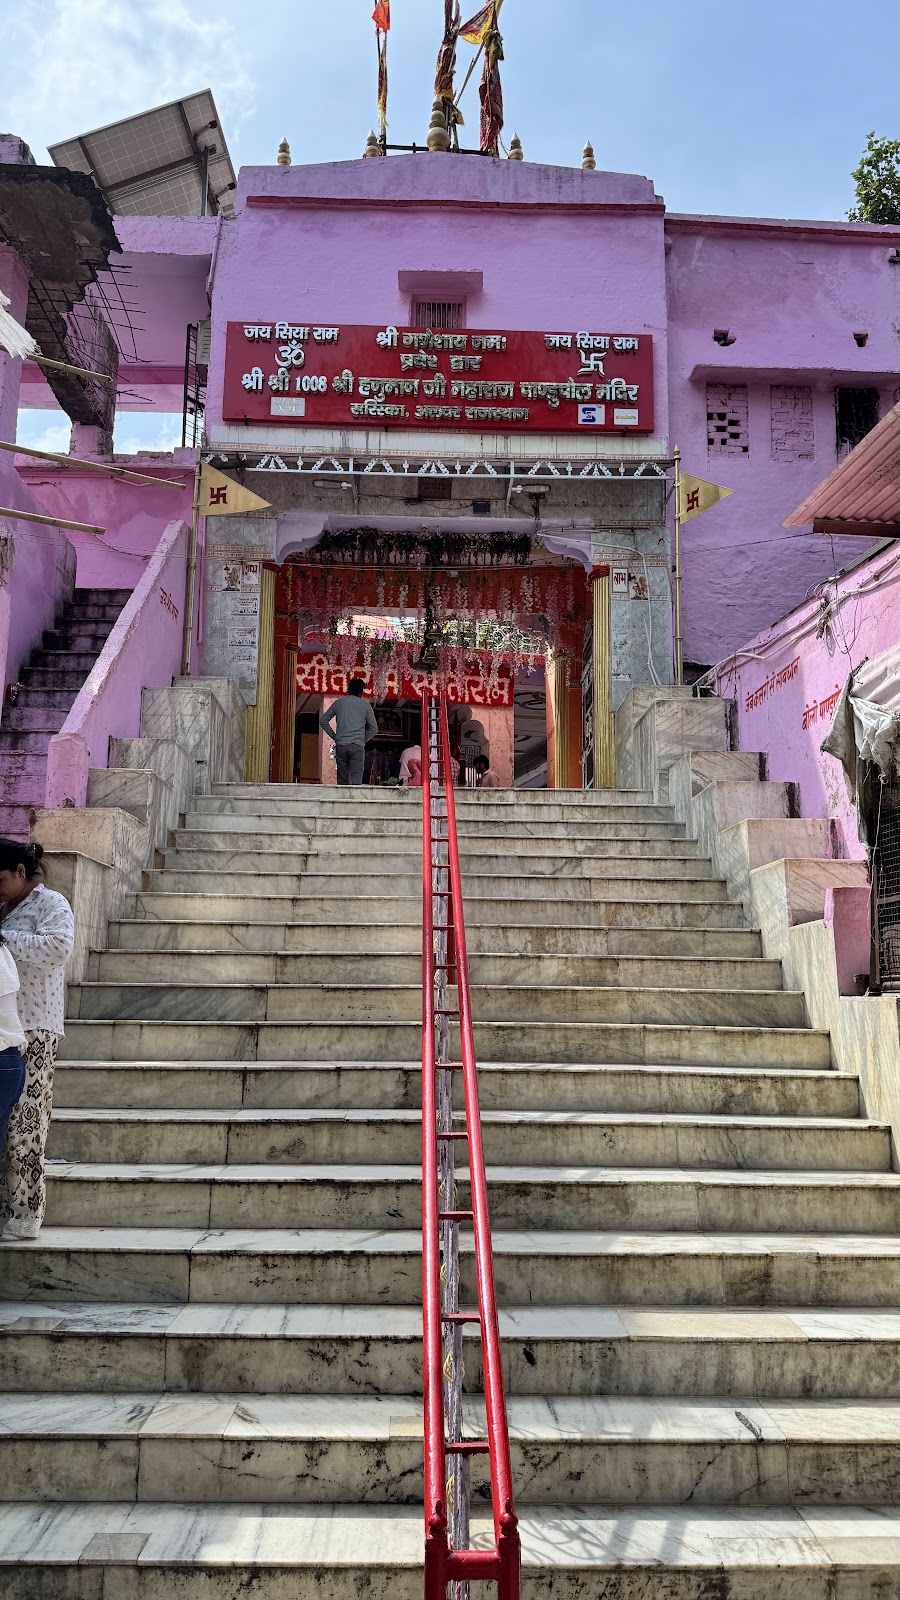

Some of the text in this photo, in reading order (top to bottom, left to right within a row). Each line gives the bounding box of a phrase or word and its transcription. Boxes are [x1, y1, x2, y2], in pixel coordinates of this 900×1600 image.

[243, 321, 339, 342] जय सिया राम
[376, 326, 507, 352] श्री गणेशाय नमः
[544, 330, 640, 351] जय सिया राम
[449, 355, 482, 372] द्वार
[241, 366, 640, 408] श्री श्री 1008 श्री हनुमान जी महाराज पाण्डुपोल मंदिर
[414, 405, 462, 421] अलवर
[464, 406, 530, 422] राजस्थान
[802, 699, 818, 730] बोलो
